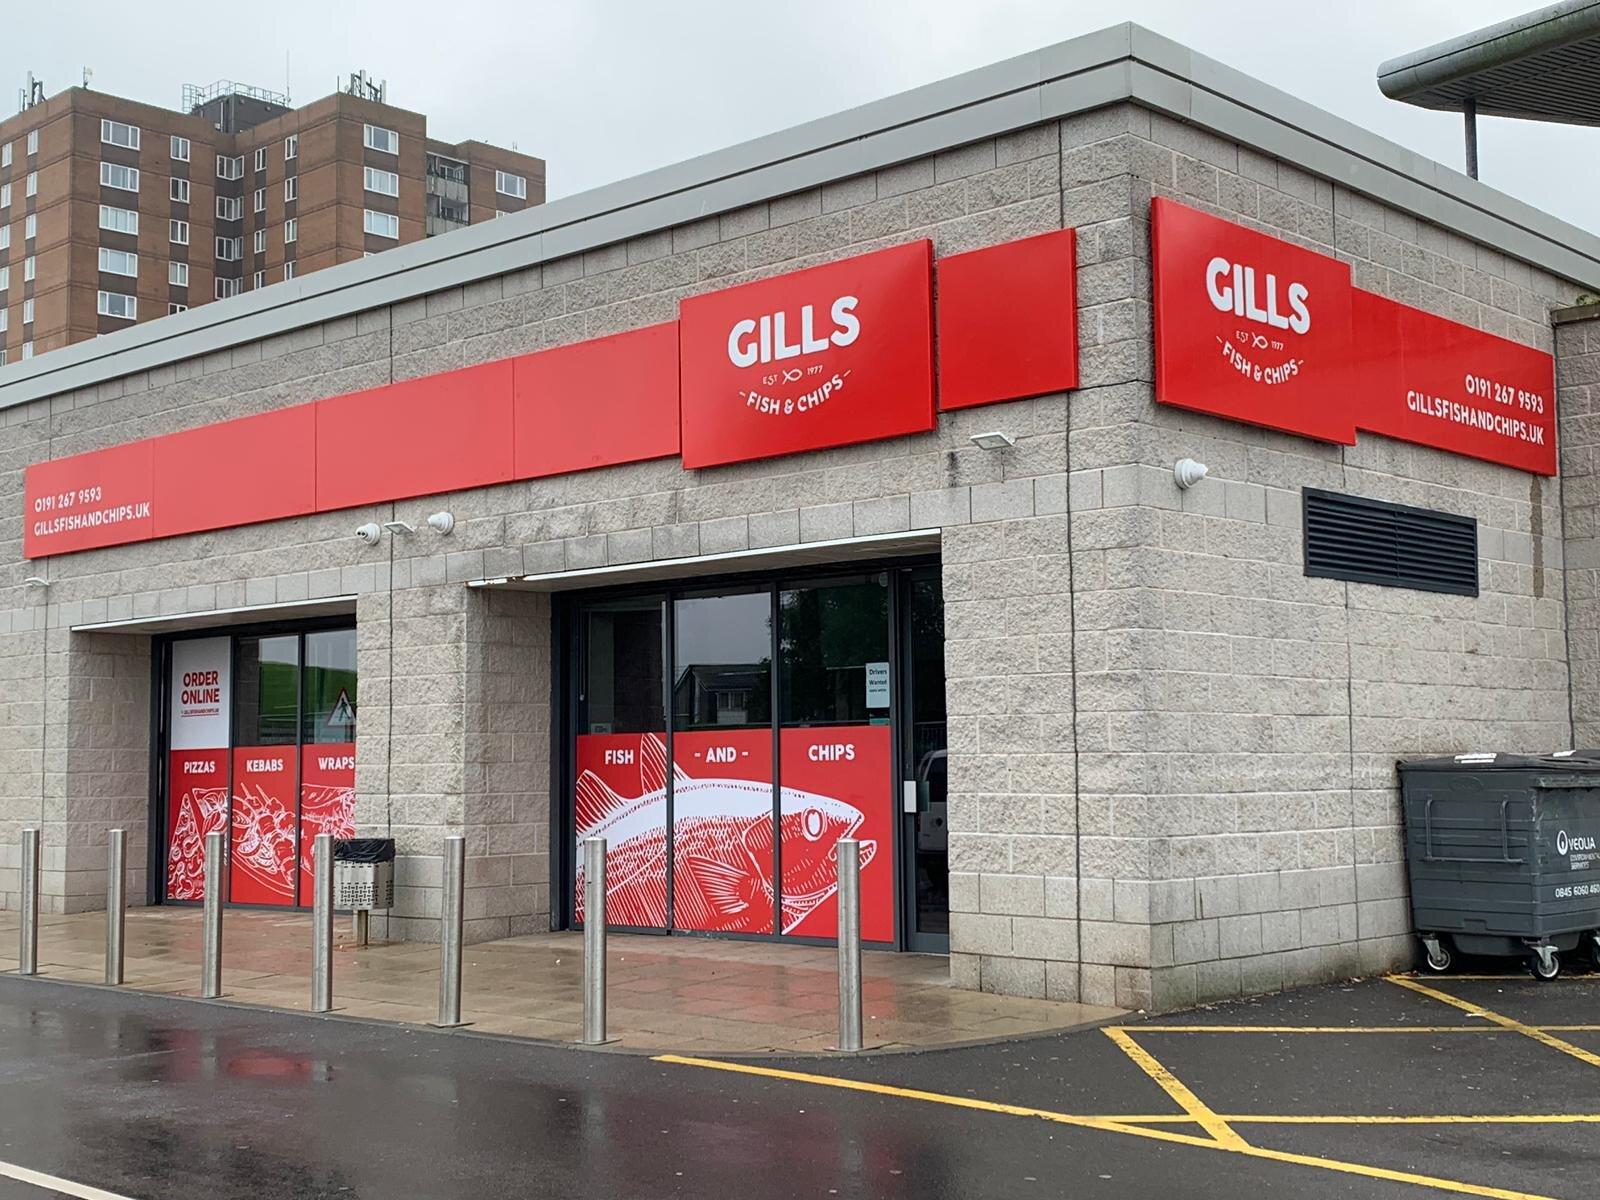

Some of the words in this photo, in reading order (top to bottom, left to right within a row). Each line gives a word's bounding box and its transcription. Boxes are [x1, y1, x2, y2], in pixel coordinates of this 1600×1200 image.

[1206, 256, 1311, 335] GILLS
[727, 295, 861, 368] GILLS
[1236, 330, 1249, 343] EST
[1222, 341, 1252, 378] FISH
[1253, 364, 1263, 382] &
[1264, 358, 1298, 385] CHIPS
[762, 373, 778, 386] EST
[807, 365, 823, 376] 1977
[746, 391, 780, 415] FISH
[783, 398, 795, 414] &
[797, 373, 844, 412] CHIPS
[1465, 374, 1492, 399] 0191
[1494, 383, 1515, 406] 267
[1518, 390, 1544, 414] 9593
[1407, 390, 1544, 445] GILLSFISHANDCHIPS.UK
[34, 495, 56, 513] 0191
[58, 491, 76, 509] 267
[78, 486, 102, 504] 9593
[34, 502, 151, 536] GILLSFISHANDCHIPS.UK
[183, 670, 219, 688] ORDER
[181, 688, 220, 705] ONLINE
[604, 749, 634, 765] FISH
[705, 747, 737, 763] AND
[808, 743, 855, 762] CHIPS
[183, 760, 216, 774] PIZZAS
[246, 759, 284, 773] KEBABS
[318, 756, 355, 771] WRAPS
[1568, 836, 1596, 850] VEOLIA
[1555, 886, 1572, 898] 0845
[1573, 884, 1589, 896] 6060
